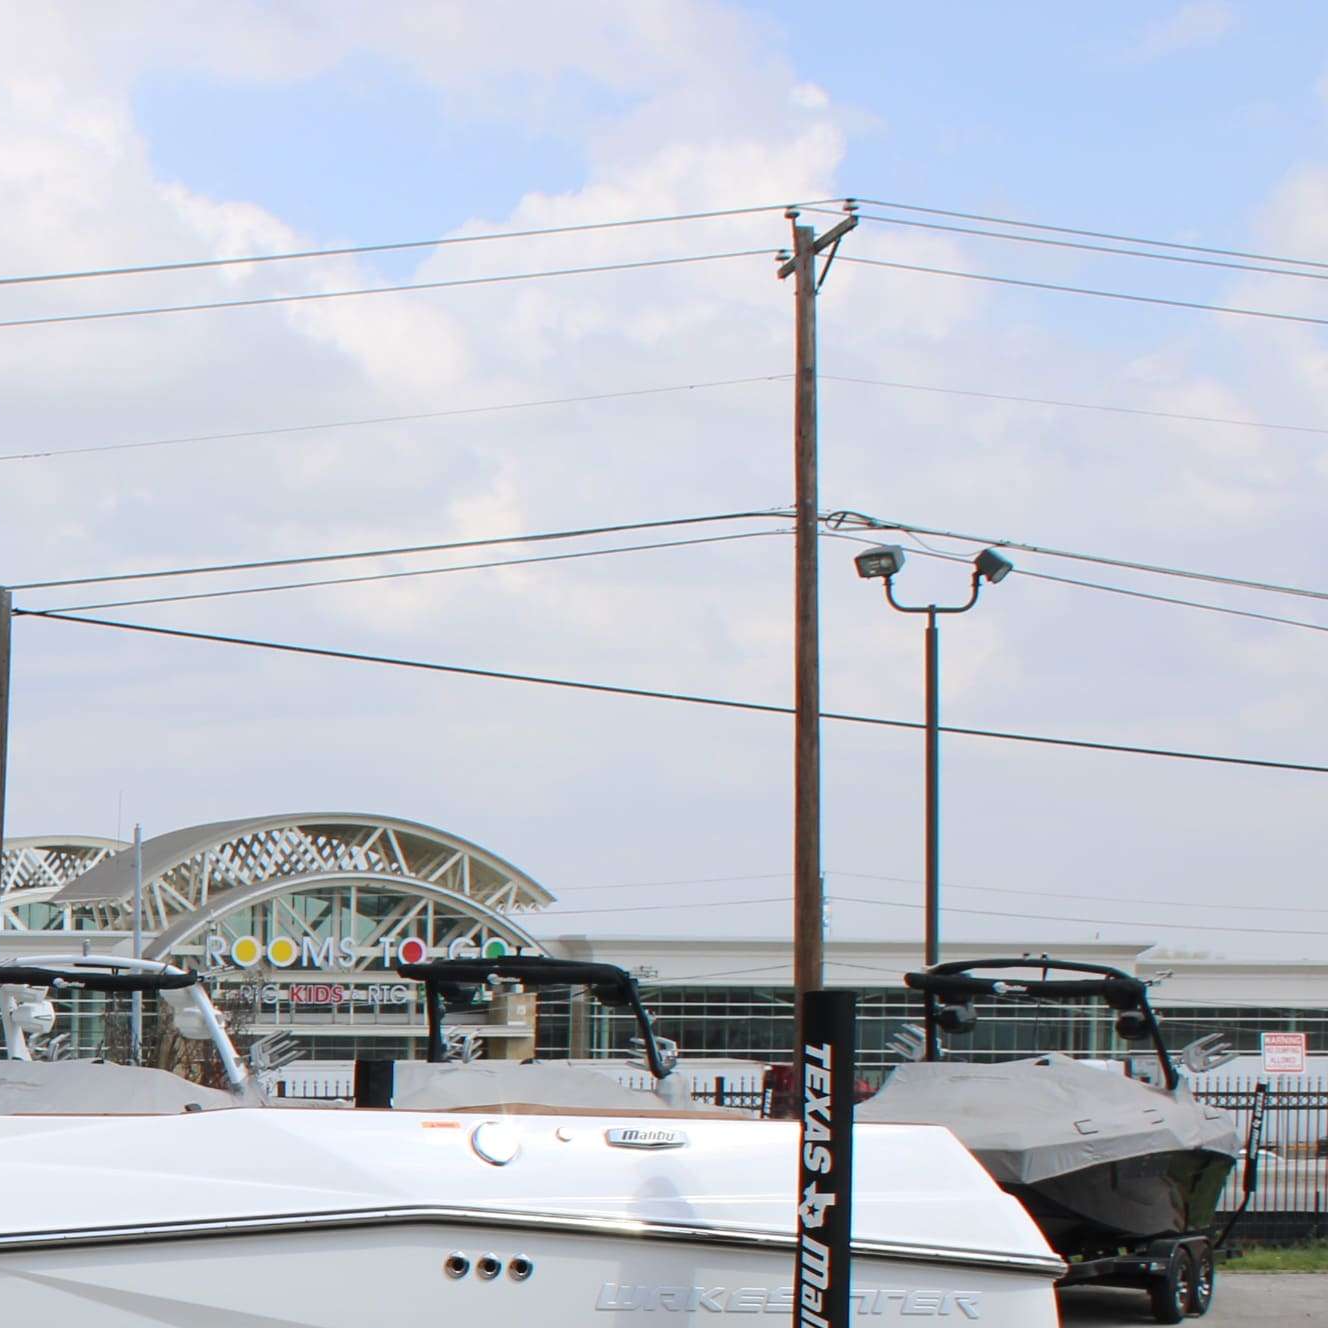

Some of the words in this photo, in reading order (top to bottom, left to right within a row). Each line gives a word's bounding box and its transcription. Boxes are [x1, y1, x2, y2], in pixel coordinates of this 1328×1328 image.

[206, 935, 357, 968] ROOMS
[379, 935, 428, 967] TO
[448, 936, 510, 959] GO
[289, 984, 344, 1003] KIDS
[367, 984, 410, 1004] RTG
[803, 1043, 832, 1174] TEXAS
[621, 1129, 675, 1142] Malibu
[595, 1281, 985, 1320] WAKESTTER
